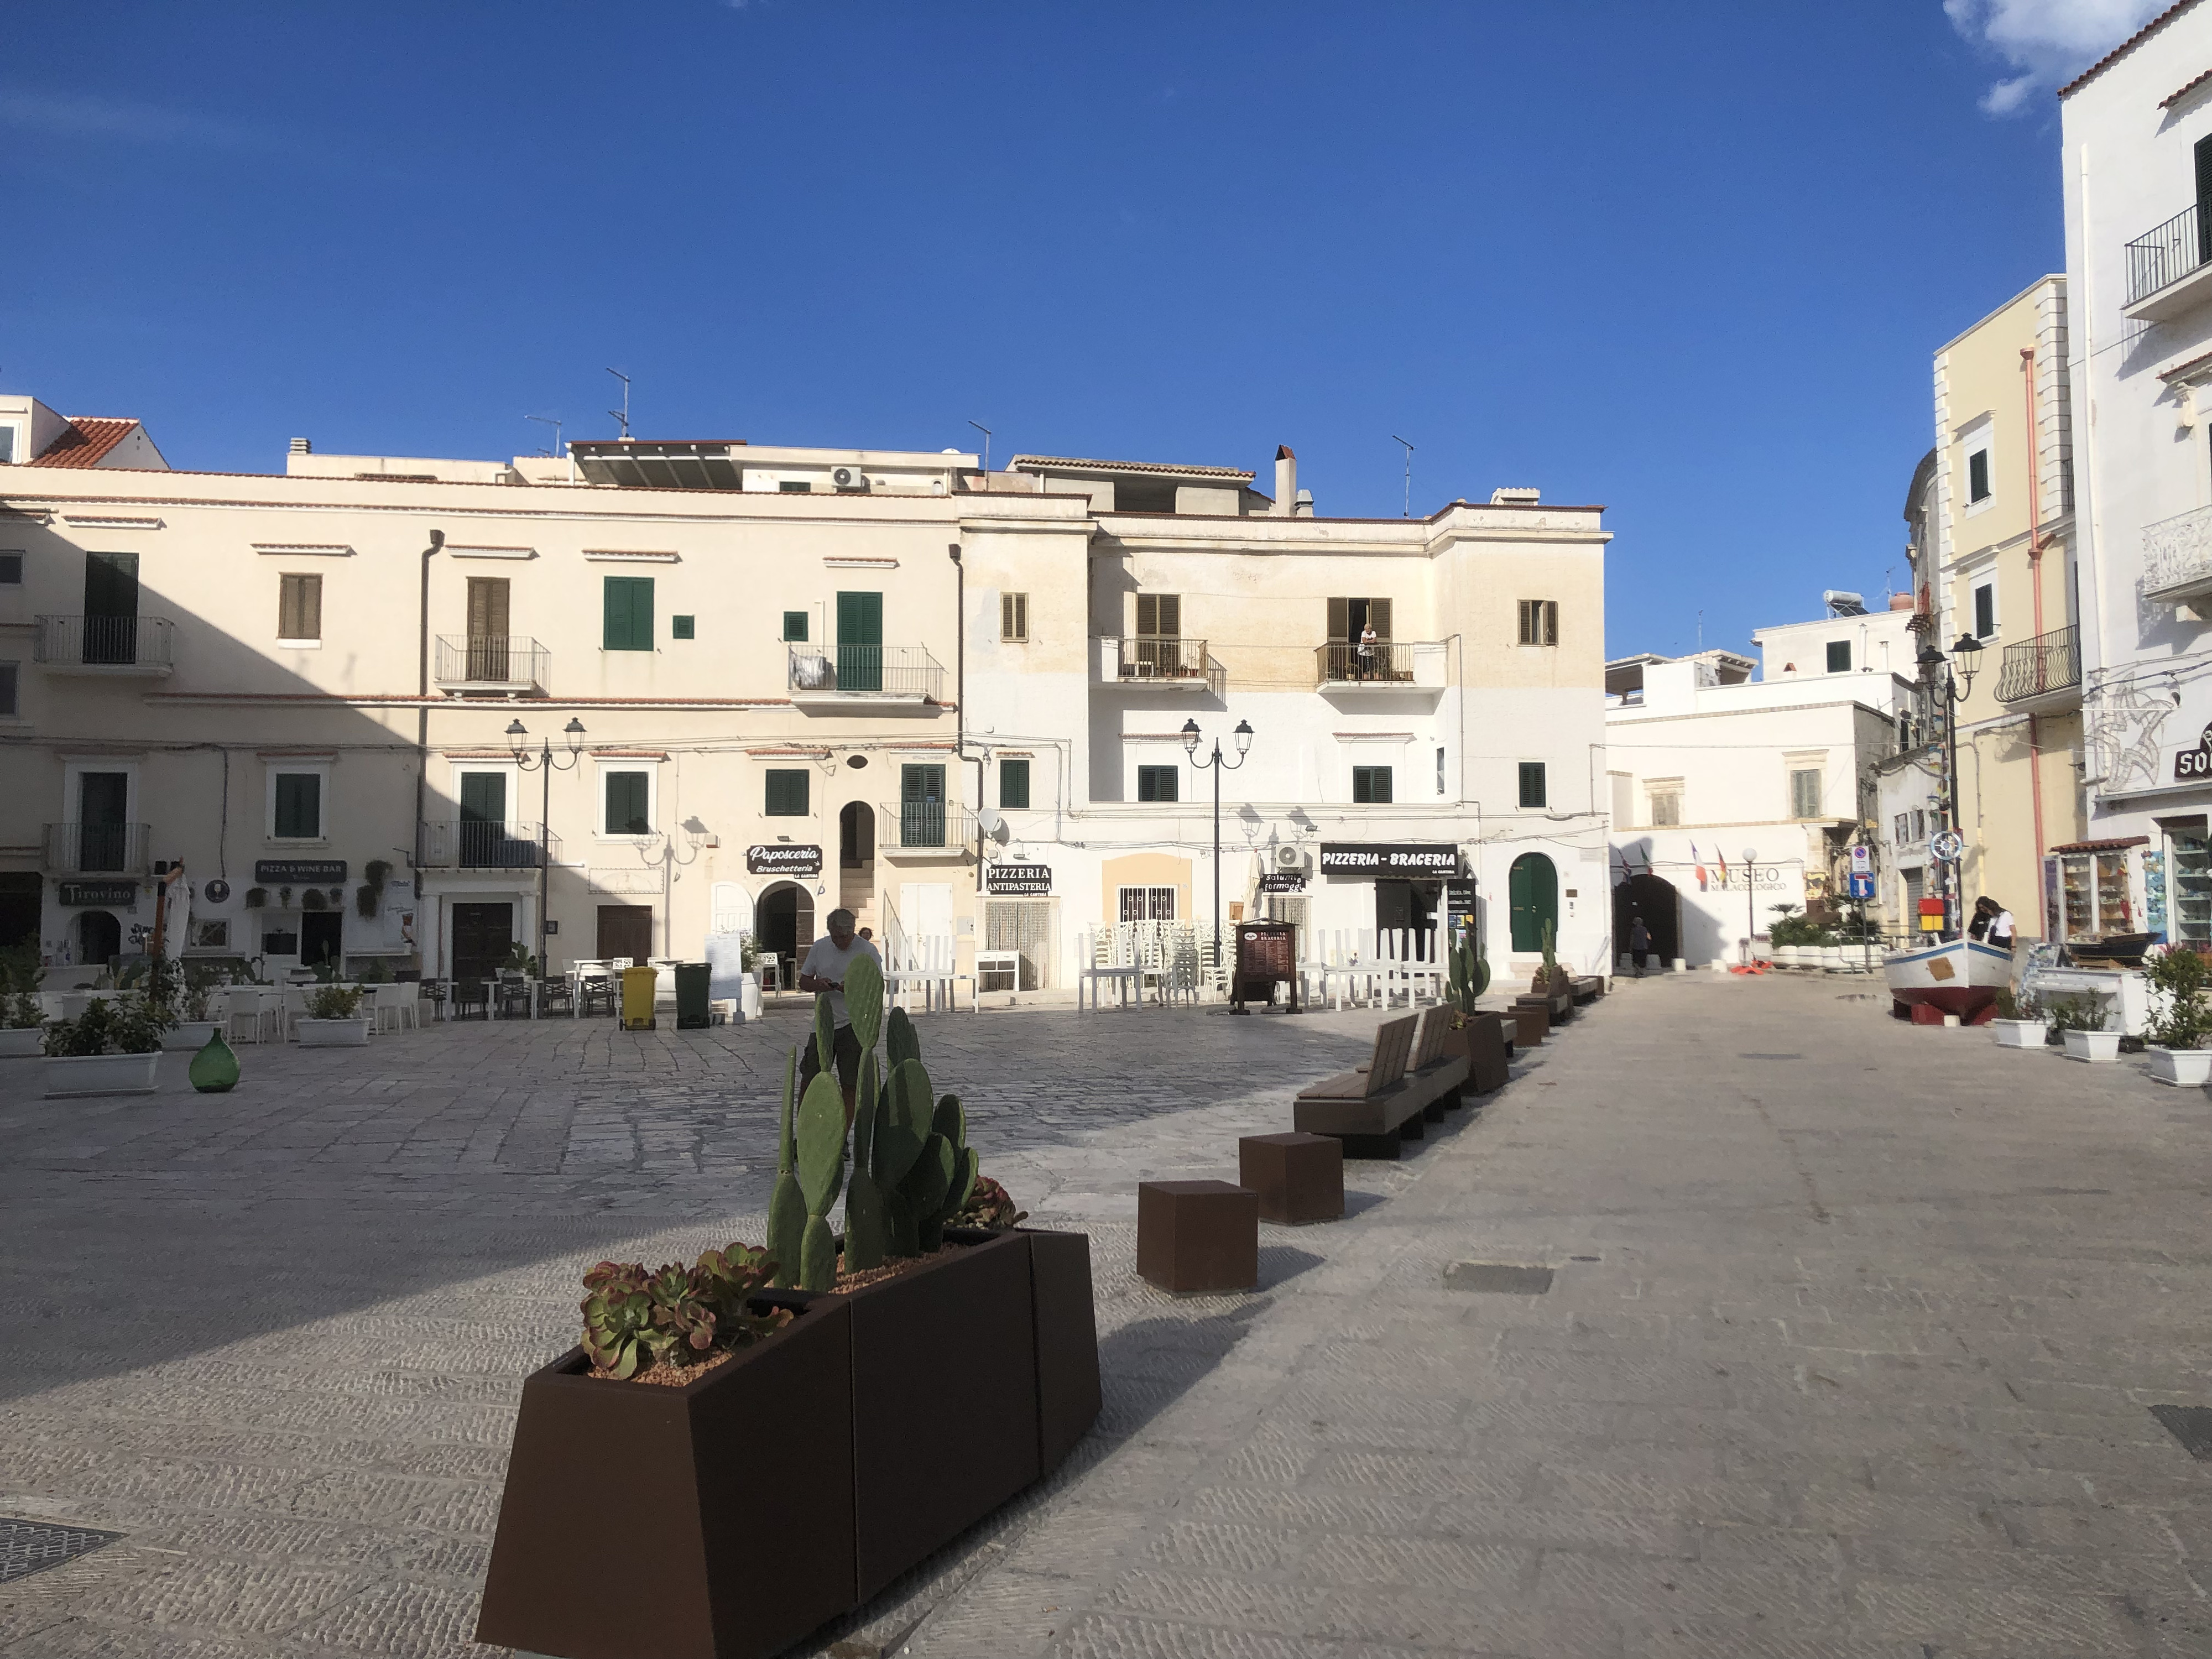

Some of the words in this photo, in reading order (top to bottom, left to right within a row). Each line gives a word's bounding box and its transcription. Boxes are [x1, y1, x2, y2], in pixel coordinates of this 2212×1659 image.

[2180, 752, 2212, 774] SO
[750, 846, 819, 863] Paposceria
[1322, 852, 1379, 867] PIZZERIA
[1389, 852, 1455, 867] BRACERIA
[756, 864, 813, 873] Bruschetteria
[988, 868, 1050, 879] PIZZERIA
[64, 884, 131, 903] Tirovino
[987, 883, 1052, 891] ANTIPASTERIA
[1265, 883, 1302, 893] formaggi
